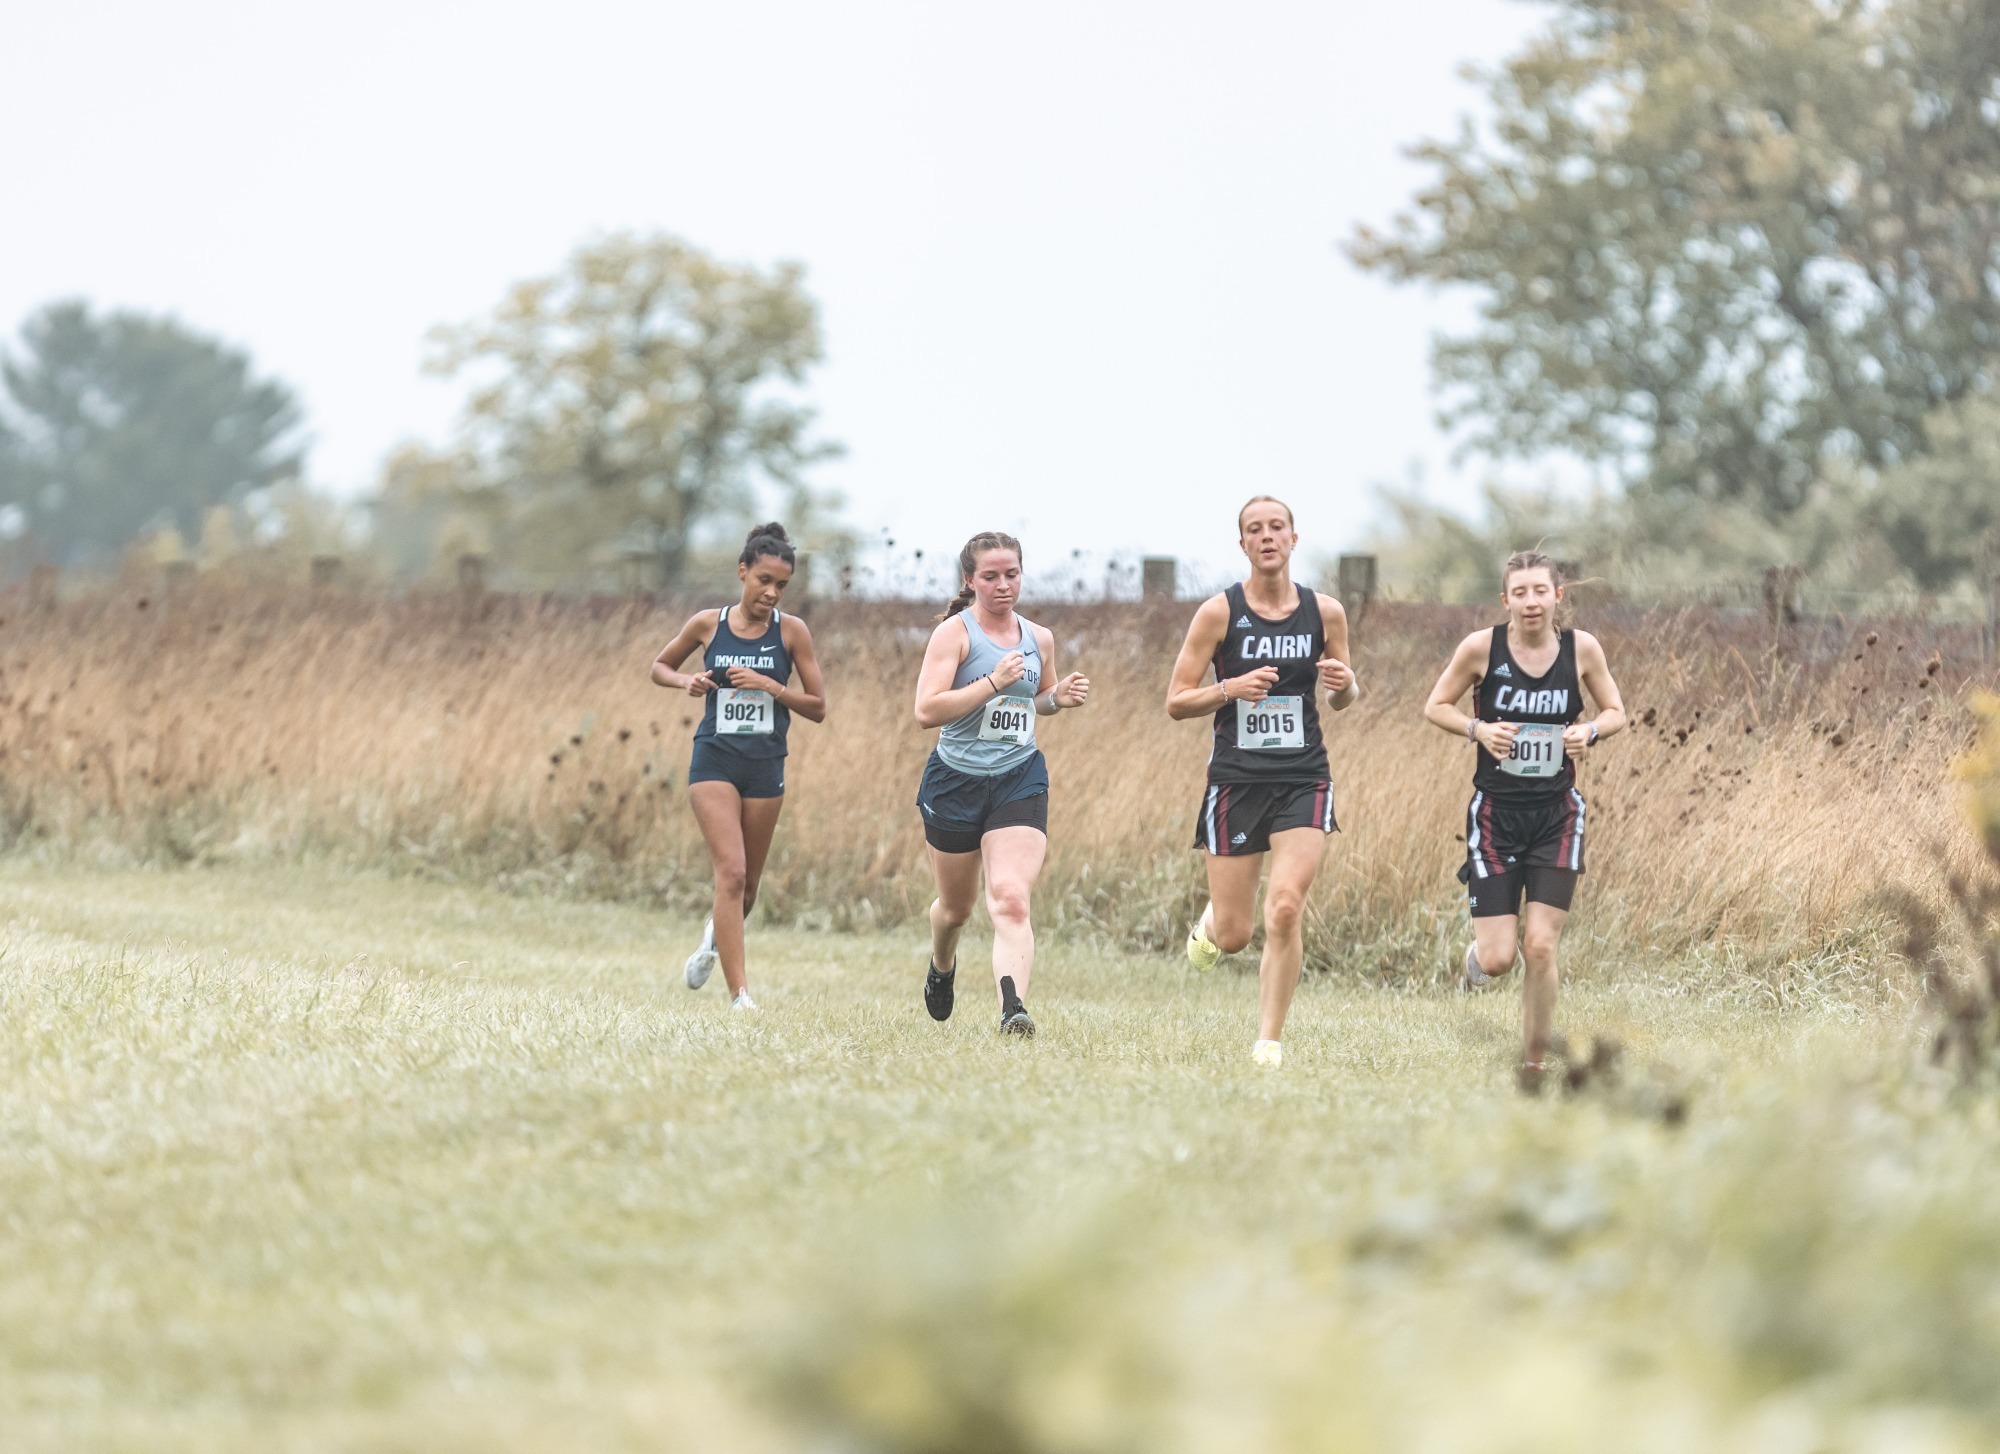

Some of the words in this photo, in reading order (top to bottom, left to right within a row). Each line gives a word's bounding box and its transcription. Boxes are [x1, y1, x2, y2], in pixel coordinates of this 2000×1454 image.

[1241, 633, 1312, 659] CAIRN
[714, 655, 775, 669] IMMACULATA
[1494, 684, 1569, 714] CAIRN
[724, 702, 765, 722] 9021
[990, 710, 1027, 732] 9041
[1246, 713, 1295, 734] 9015
